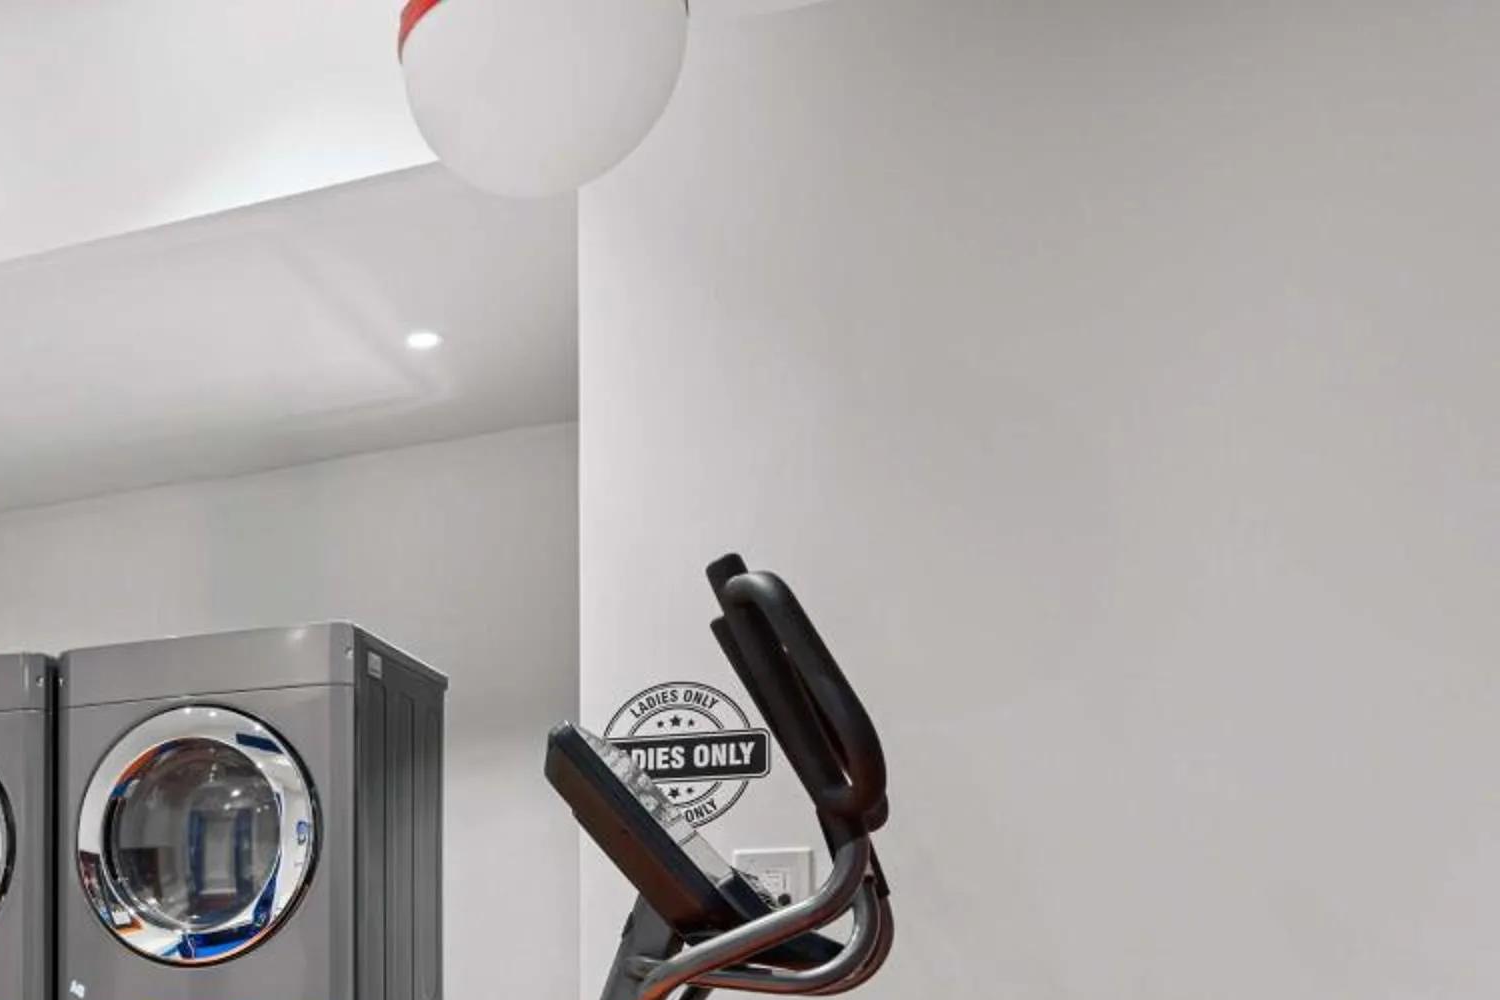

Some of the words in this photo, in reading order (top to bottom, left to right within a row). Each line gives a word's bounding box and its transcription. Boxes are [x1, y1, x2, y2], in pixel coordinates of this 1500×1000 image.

[630, 690, 678, 718] LADIES
[684, 690, 719, 709] ONLY
[631, 746, 685, 770] DIES
[693, 742, 756, 767] ONLY
[685, 800, 718, 823] ONLY
